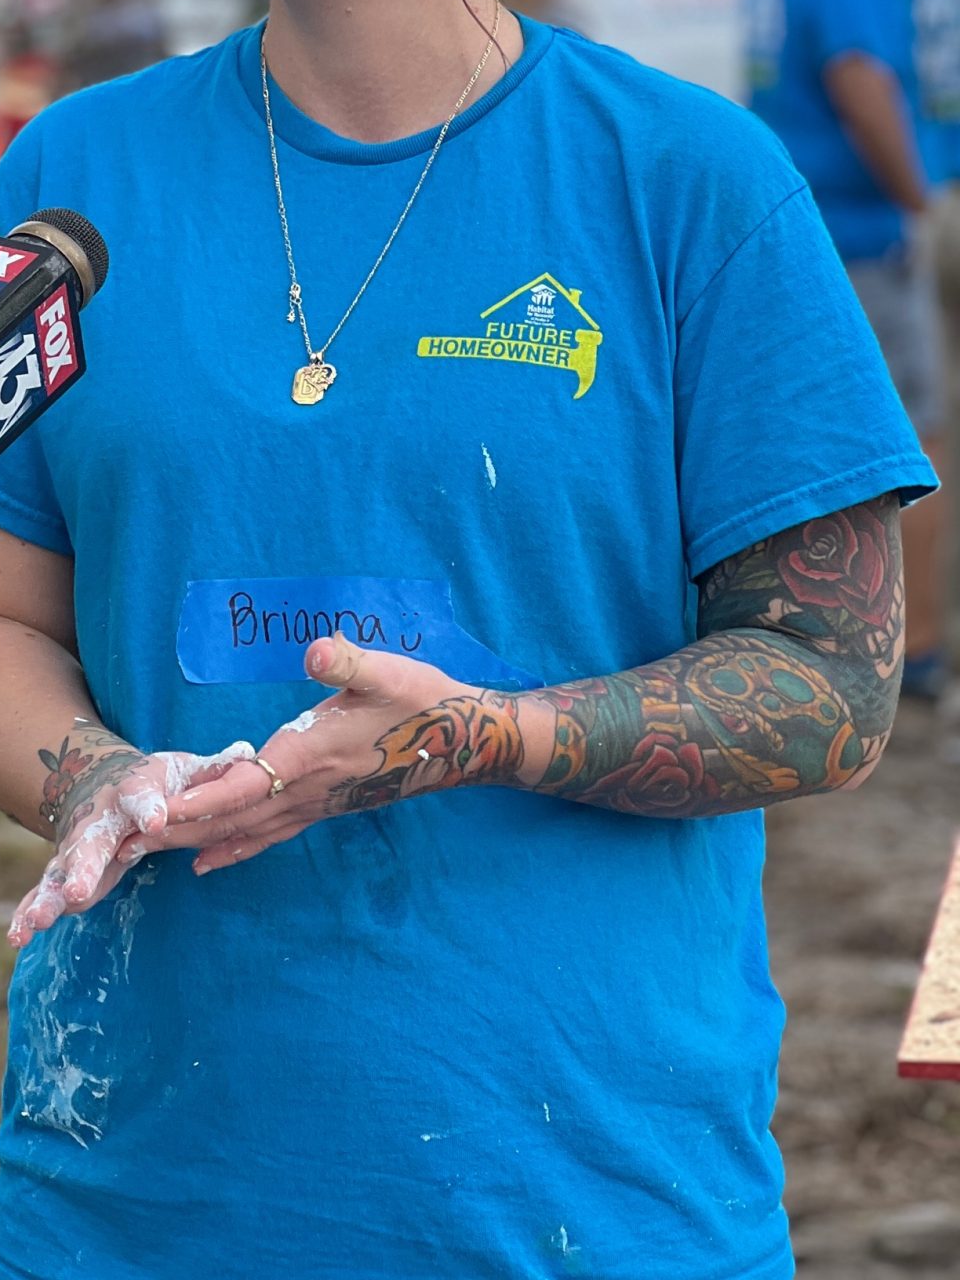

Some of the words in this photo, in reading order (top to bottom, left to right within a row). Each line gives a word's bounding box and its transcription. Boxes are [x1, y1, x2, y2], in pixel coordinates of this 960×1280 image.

[39, 298, 73, 385] FOX
[427, 339, 570, 367] HOMEOWNER
[486, 322, 573, 347] FUTURE
[228, 592, 388, 648] Brianna
